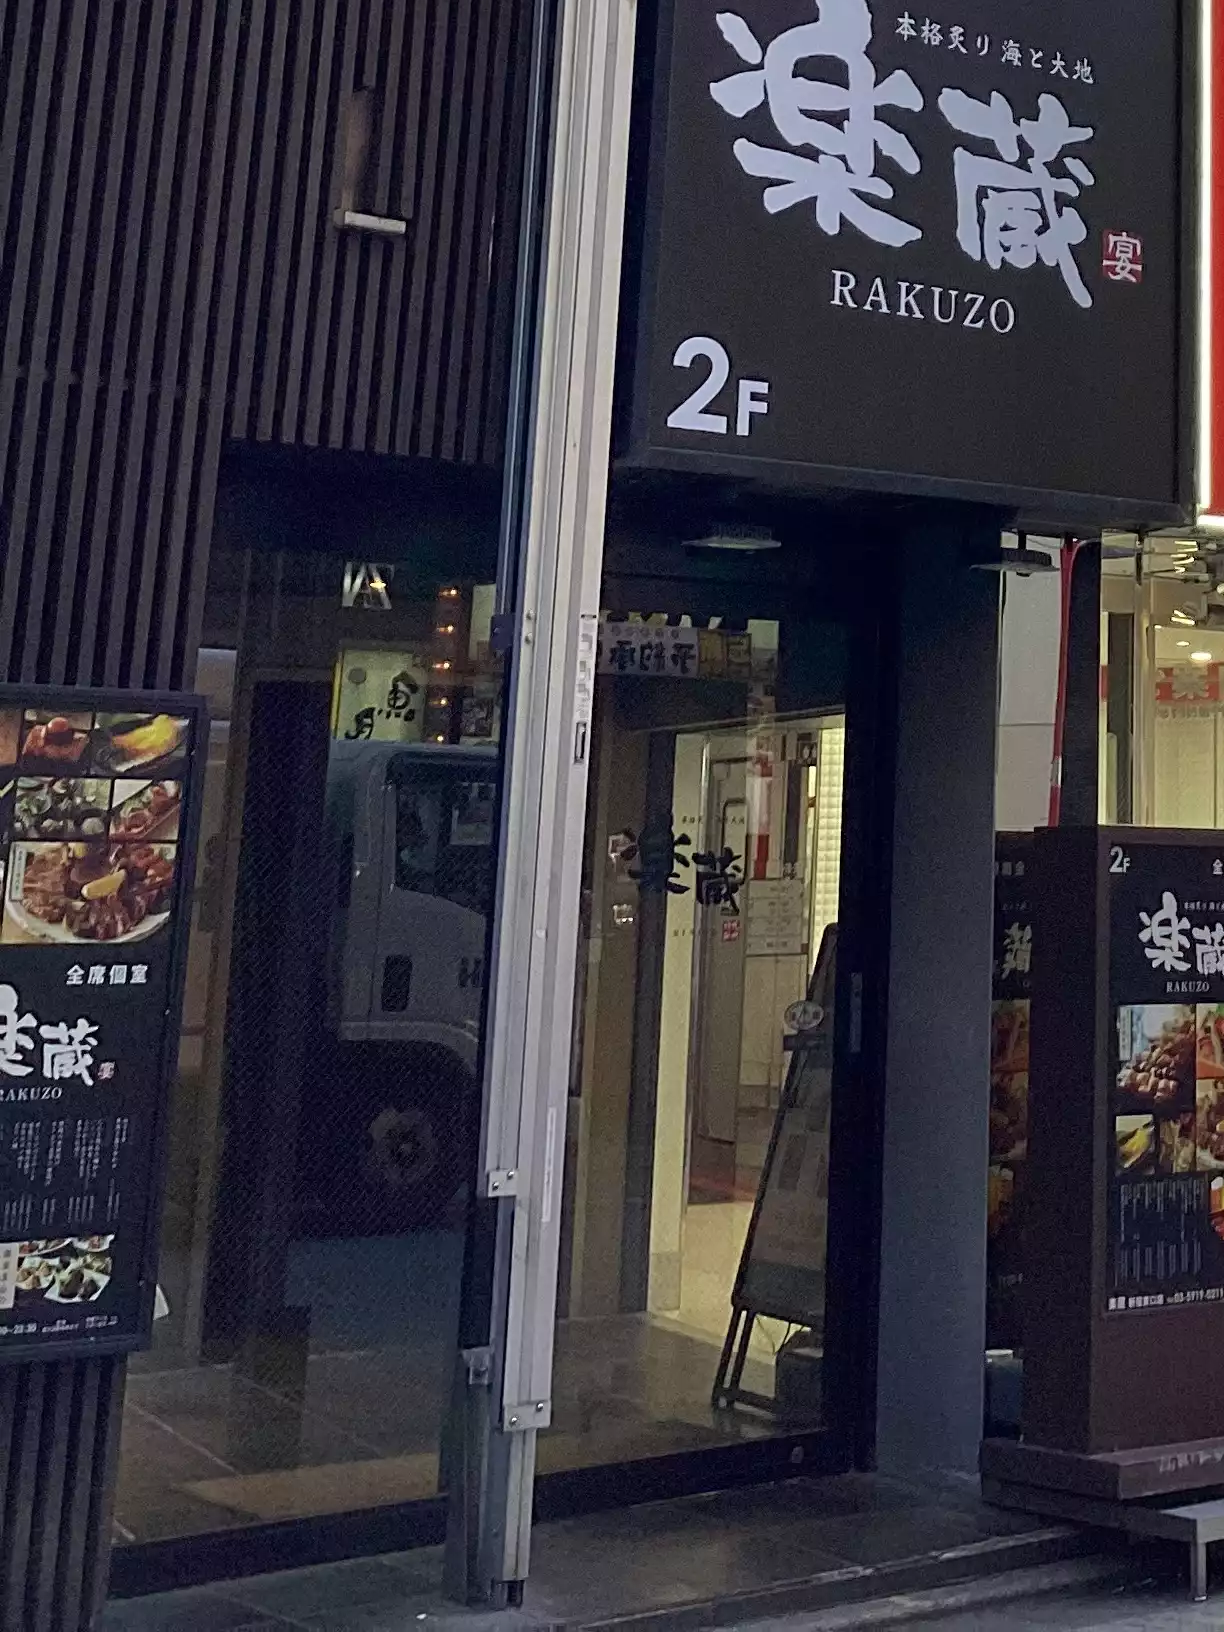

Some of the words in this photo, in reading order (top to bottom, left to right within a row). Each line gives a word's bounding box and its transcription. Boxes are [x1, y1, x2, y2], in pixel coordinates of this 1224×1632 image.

[1102, 231, 1142, 283] 宴
[830, 269, 1016, 334] RAKUZO
[666, 335, 770, 437] 2F
[1109, 846, 1131, 873] 2F
[66, 963, 149, 985] 全席個室
[1166, 981, 1210, 993] RAKUZO
